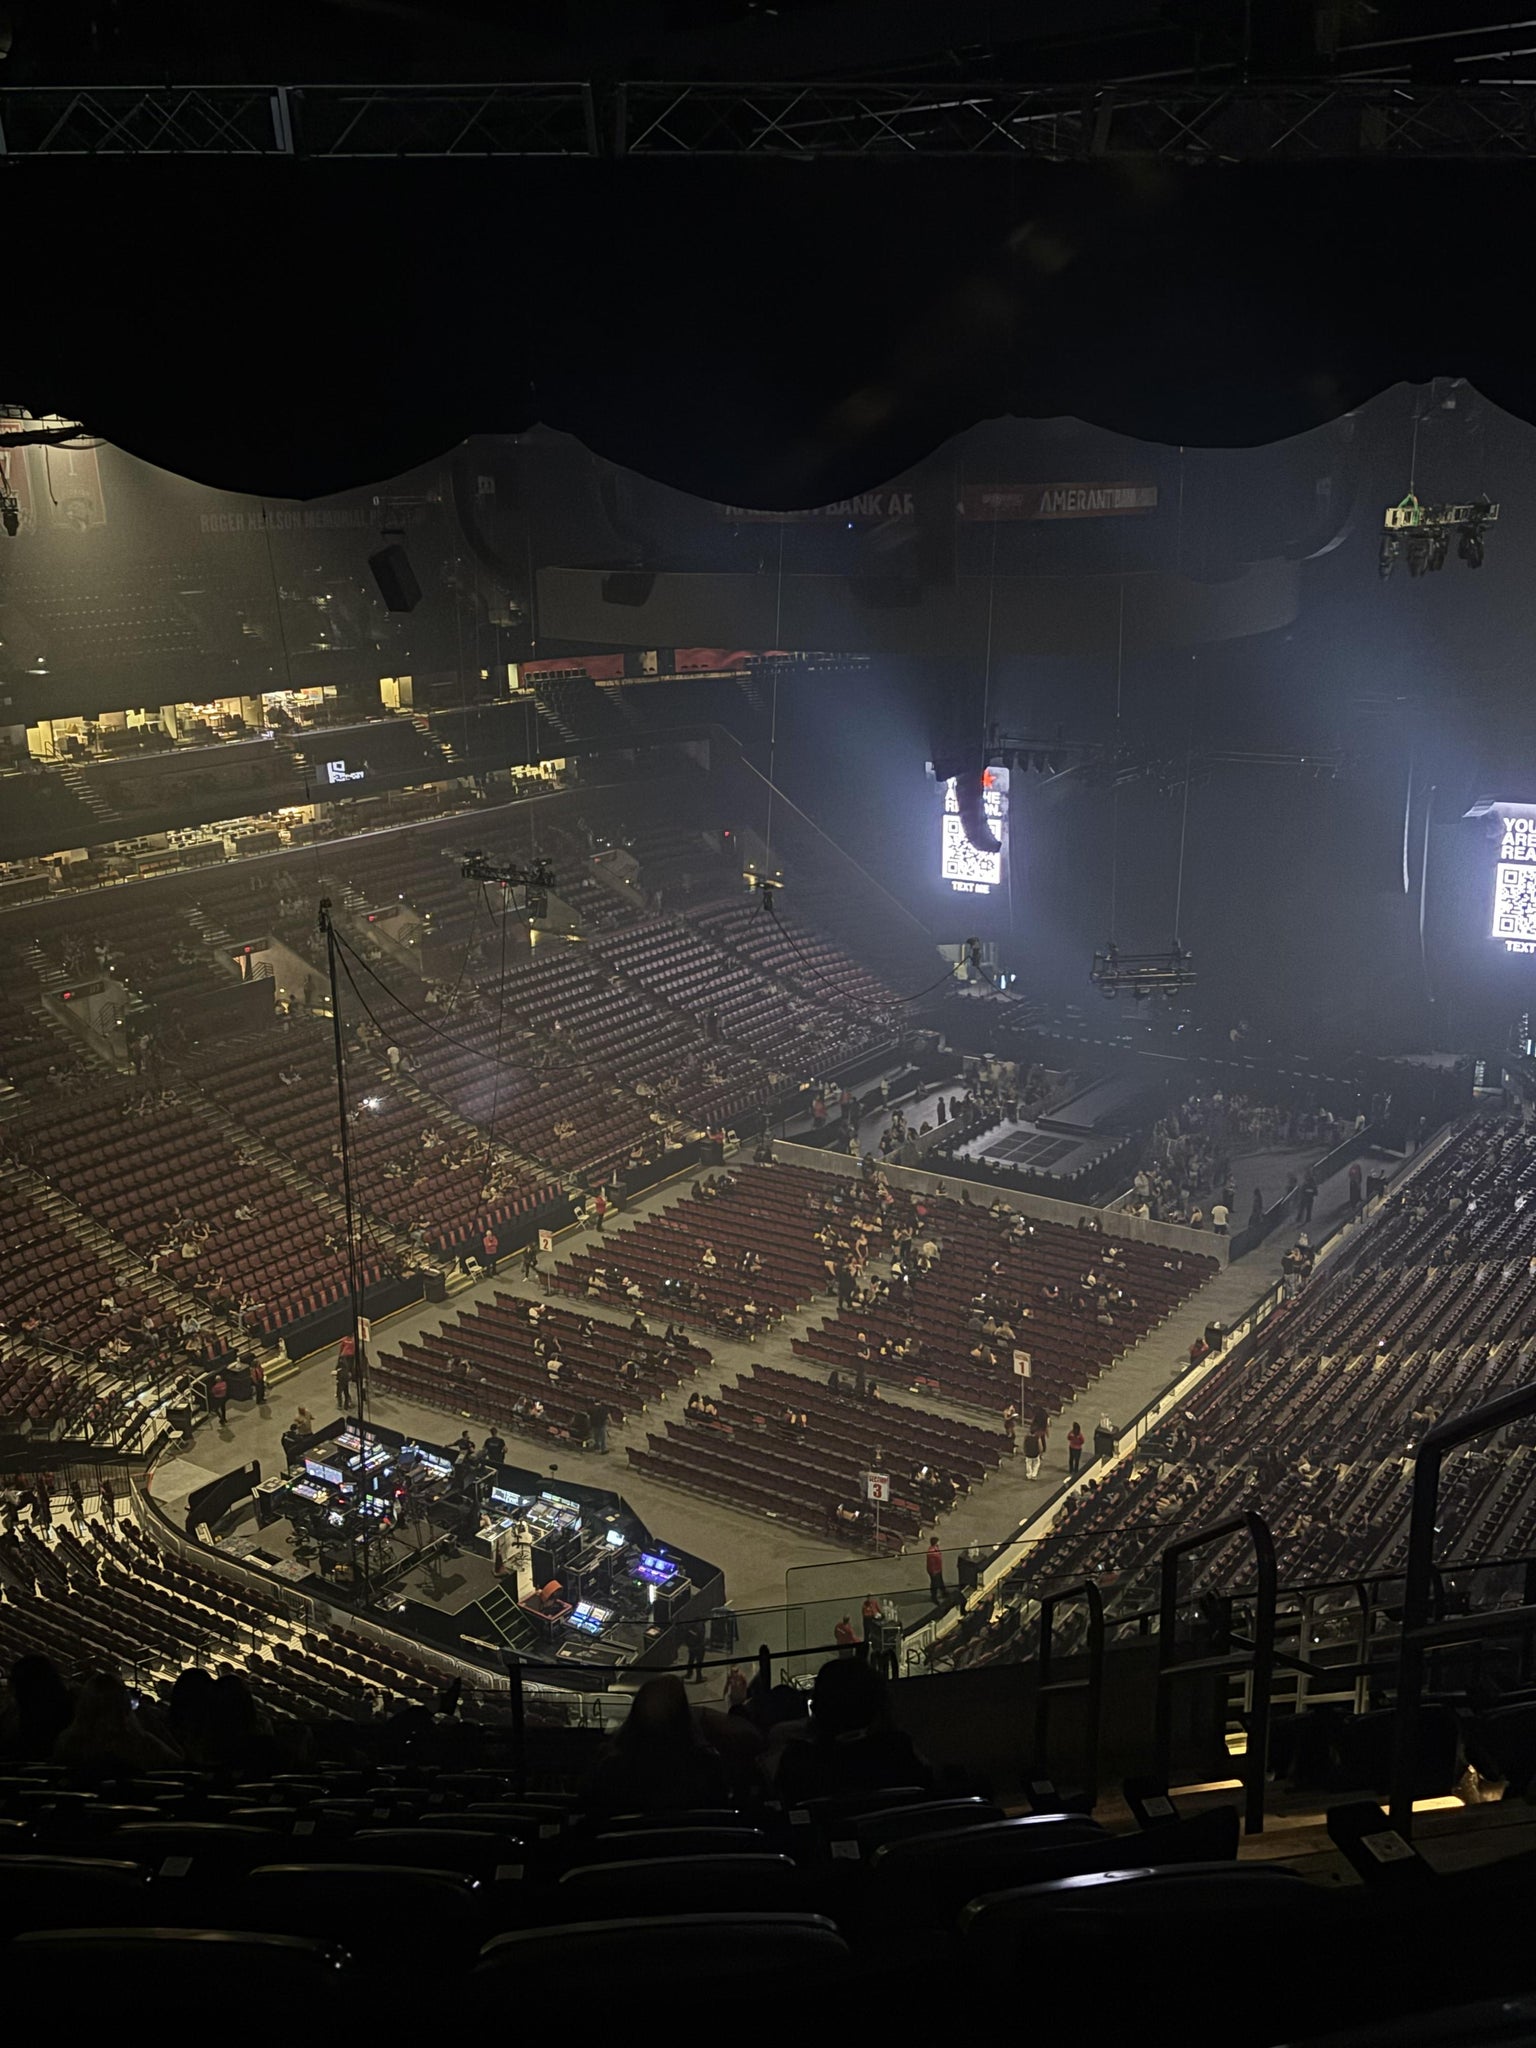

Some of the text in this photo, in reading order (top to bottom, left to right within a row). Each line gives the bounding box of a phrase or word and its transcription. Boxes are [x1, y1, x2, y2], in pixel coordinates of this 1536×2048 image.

[1040, 488, 1113, 513] AMERANT
[199, 513, 244, 532] ROGER
[1505, 940, 1536, 954] TEXT
[543, 1238, 549, 1250] 2
[1018, 1361, 1025, 1374] 1
[873, 1483, 882, 1498] 3
